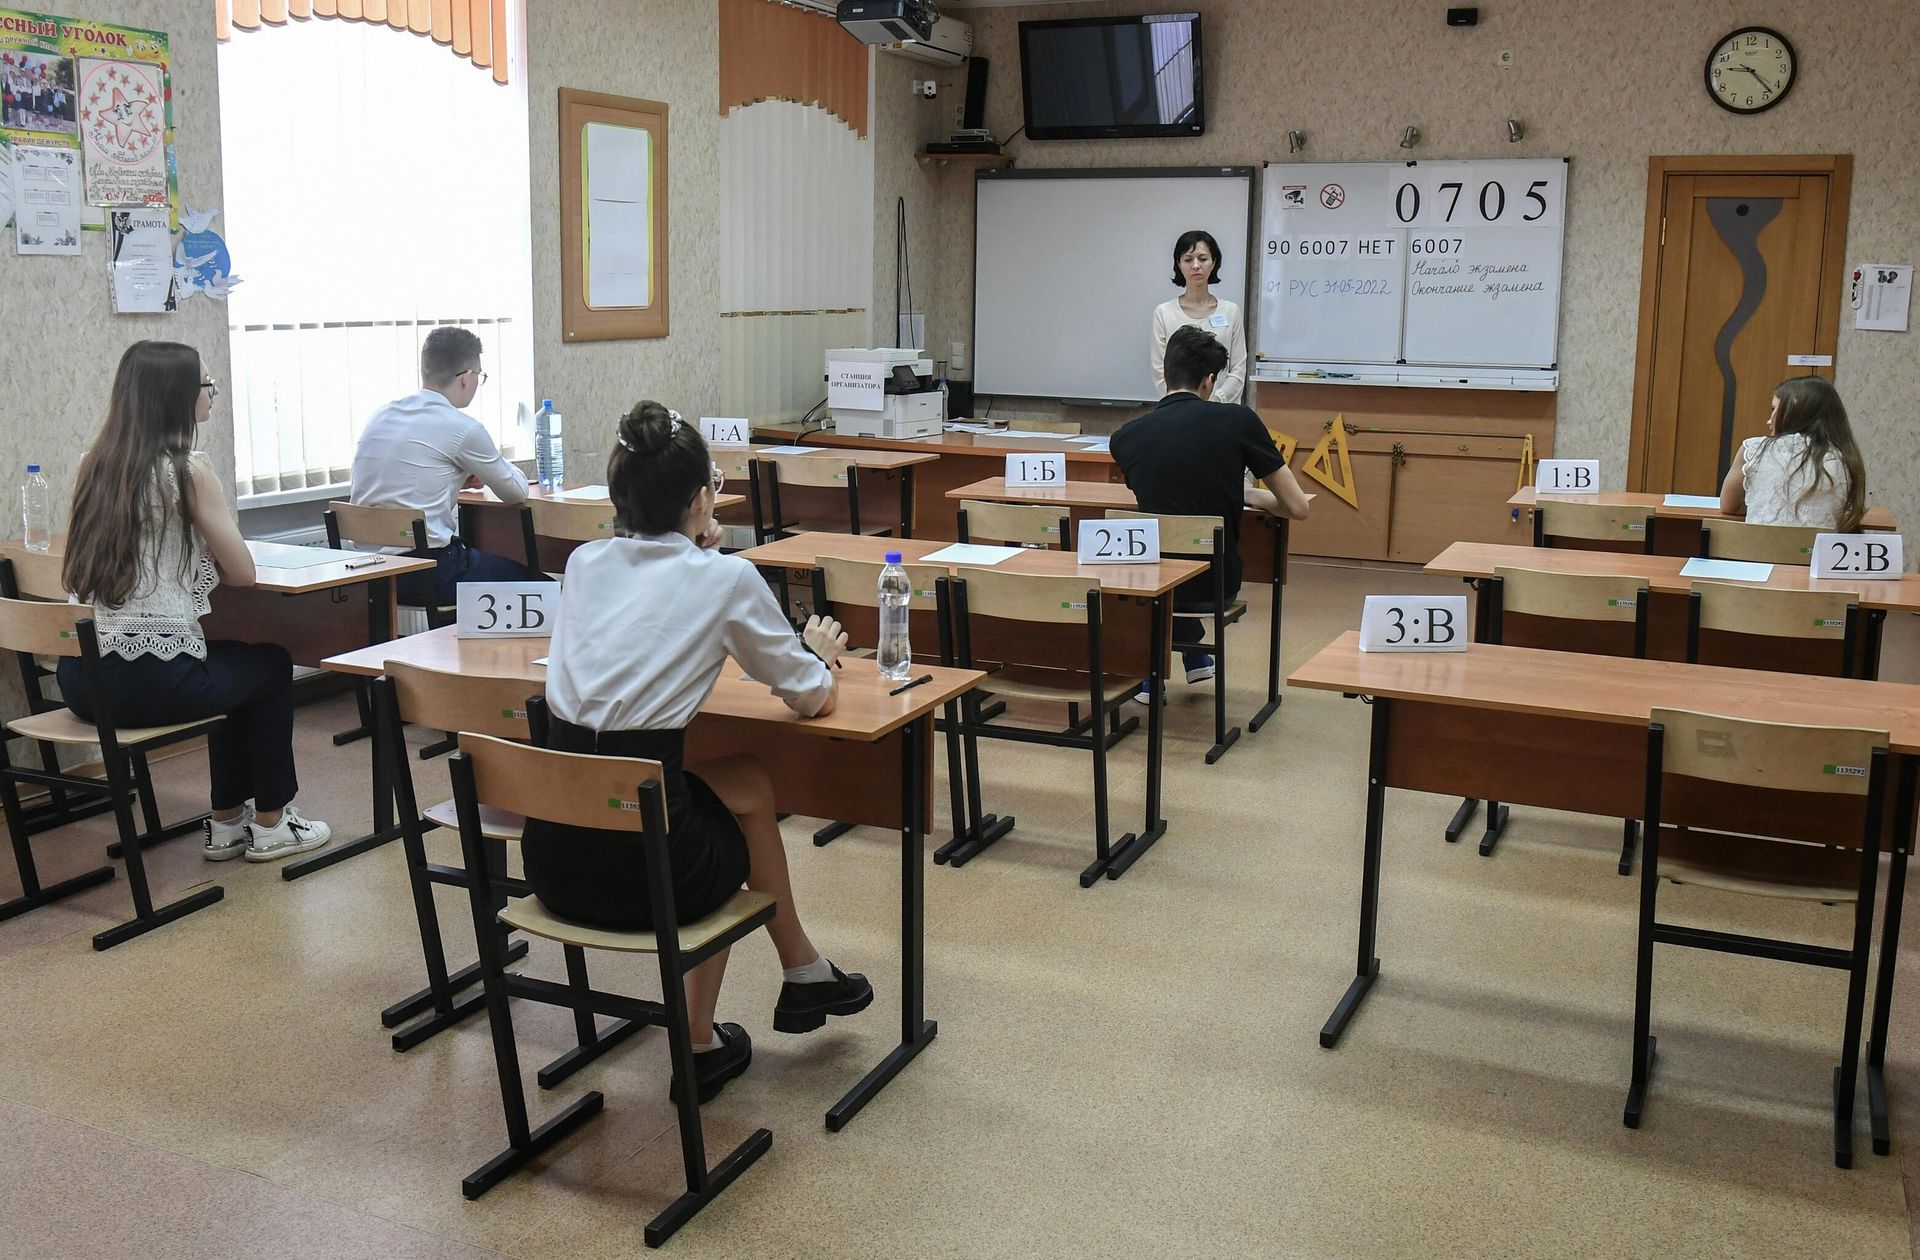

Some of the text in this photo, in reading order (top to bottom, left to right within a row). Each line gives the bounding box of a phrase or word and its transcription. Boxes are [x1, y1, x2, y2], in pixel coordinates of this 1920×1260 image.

[0, 17, 127, 47] СНЫЙ УГОЛОК
[1732, 41, 1739, 51] 11
[1746, 36, 1757, 46] 12
[1765, 39, 1769, 48] 1
[1720, 53, 1729, 62] 10
[1776, 49, 1782, 59] 2
[1714, 68, 1721, 78] 9
[1780, 64, 1786, 73] 3
[1719, 83, 1726, 92] 8
[1775, 80, 1780, 89] 4
[1731, 93, 1737, 102] 7
[1746, 96, 1753, 105] 6
[1762, 91, 1769, 100] 5
[1395, 181, 1548, 223] 0705
[133, 220, 167, 229] ГРАМОТА
[1268, 239, 1463, 255] 90 6007 НЕТ 6007
[1411, 259, 1529, 281] Начало экзамена
[1266, 281, 1281, 293] 01
[1289, 280, 1319, 297] РУС
[1412, 280, 1544, 300] Окончание экзамена
[831, 381, 881, 389] ОРГАНИЗАТОРА
[710, 424, 743, 441] 1:А
[1020, 460, 1056, 481] 1:Б
[1552, 466, 1591, 488] 1:В
[1095, 528, 1147, 557] 2:Б
[1830, 541, 1890, 572] 2:В
[478, 594, 545, 630] 3:Б
[1385, 607, 1455, 644] 3:В
[1837, 767, 1865, 775] 1135292
